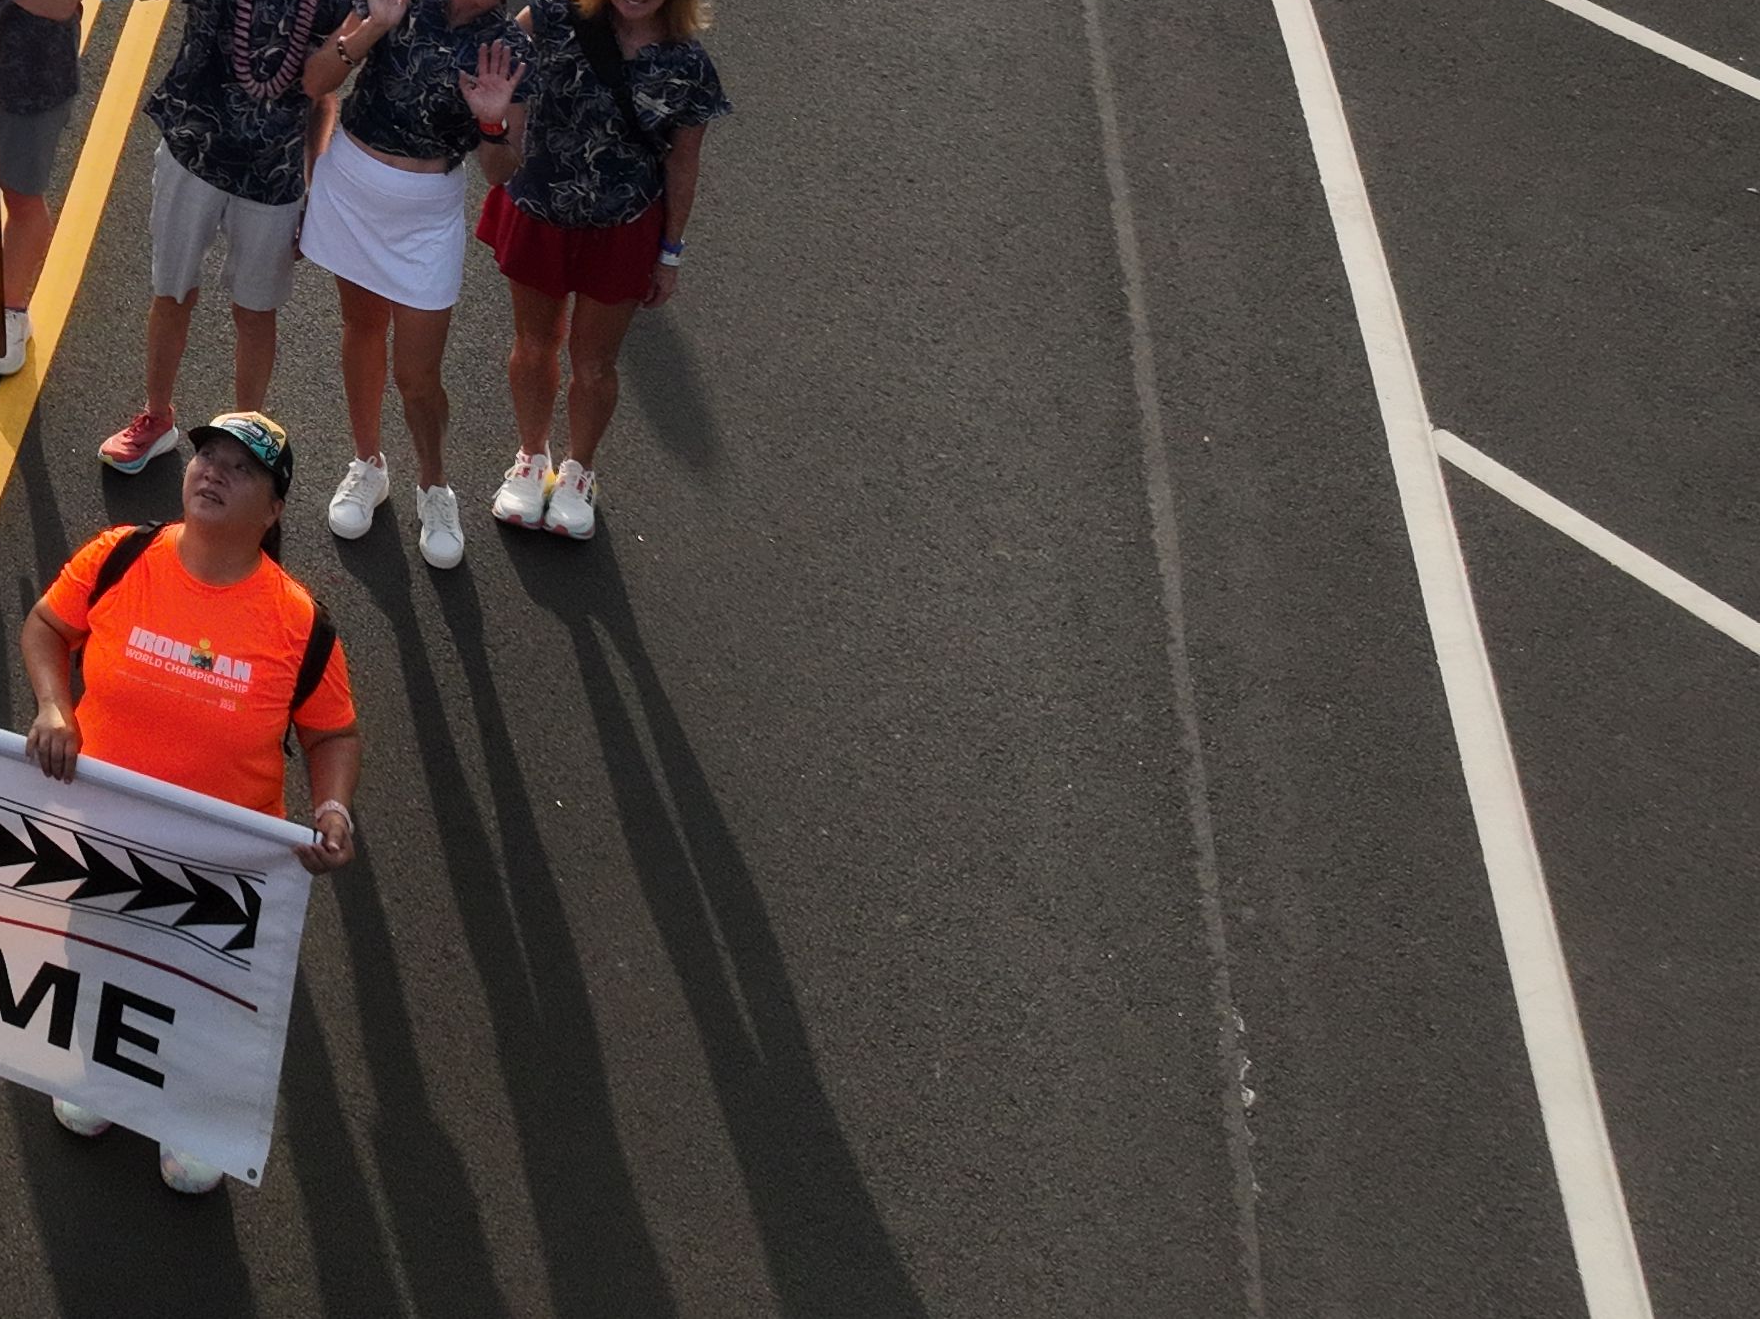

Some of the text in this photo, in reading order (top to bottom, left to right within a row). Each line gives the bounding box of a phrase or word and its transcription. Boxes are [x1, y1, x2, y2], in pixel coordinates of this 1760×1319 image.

[125, 647, 162, 668] WORLD
[164, 661, 249, 694] CHAMPIONSHIP
[128, 626, 253, 683] IRONMAN
